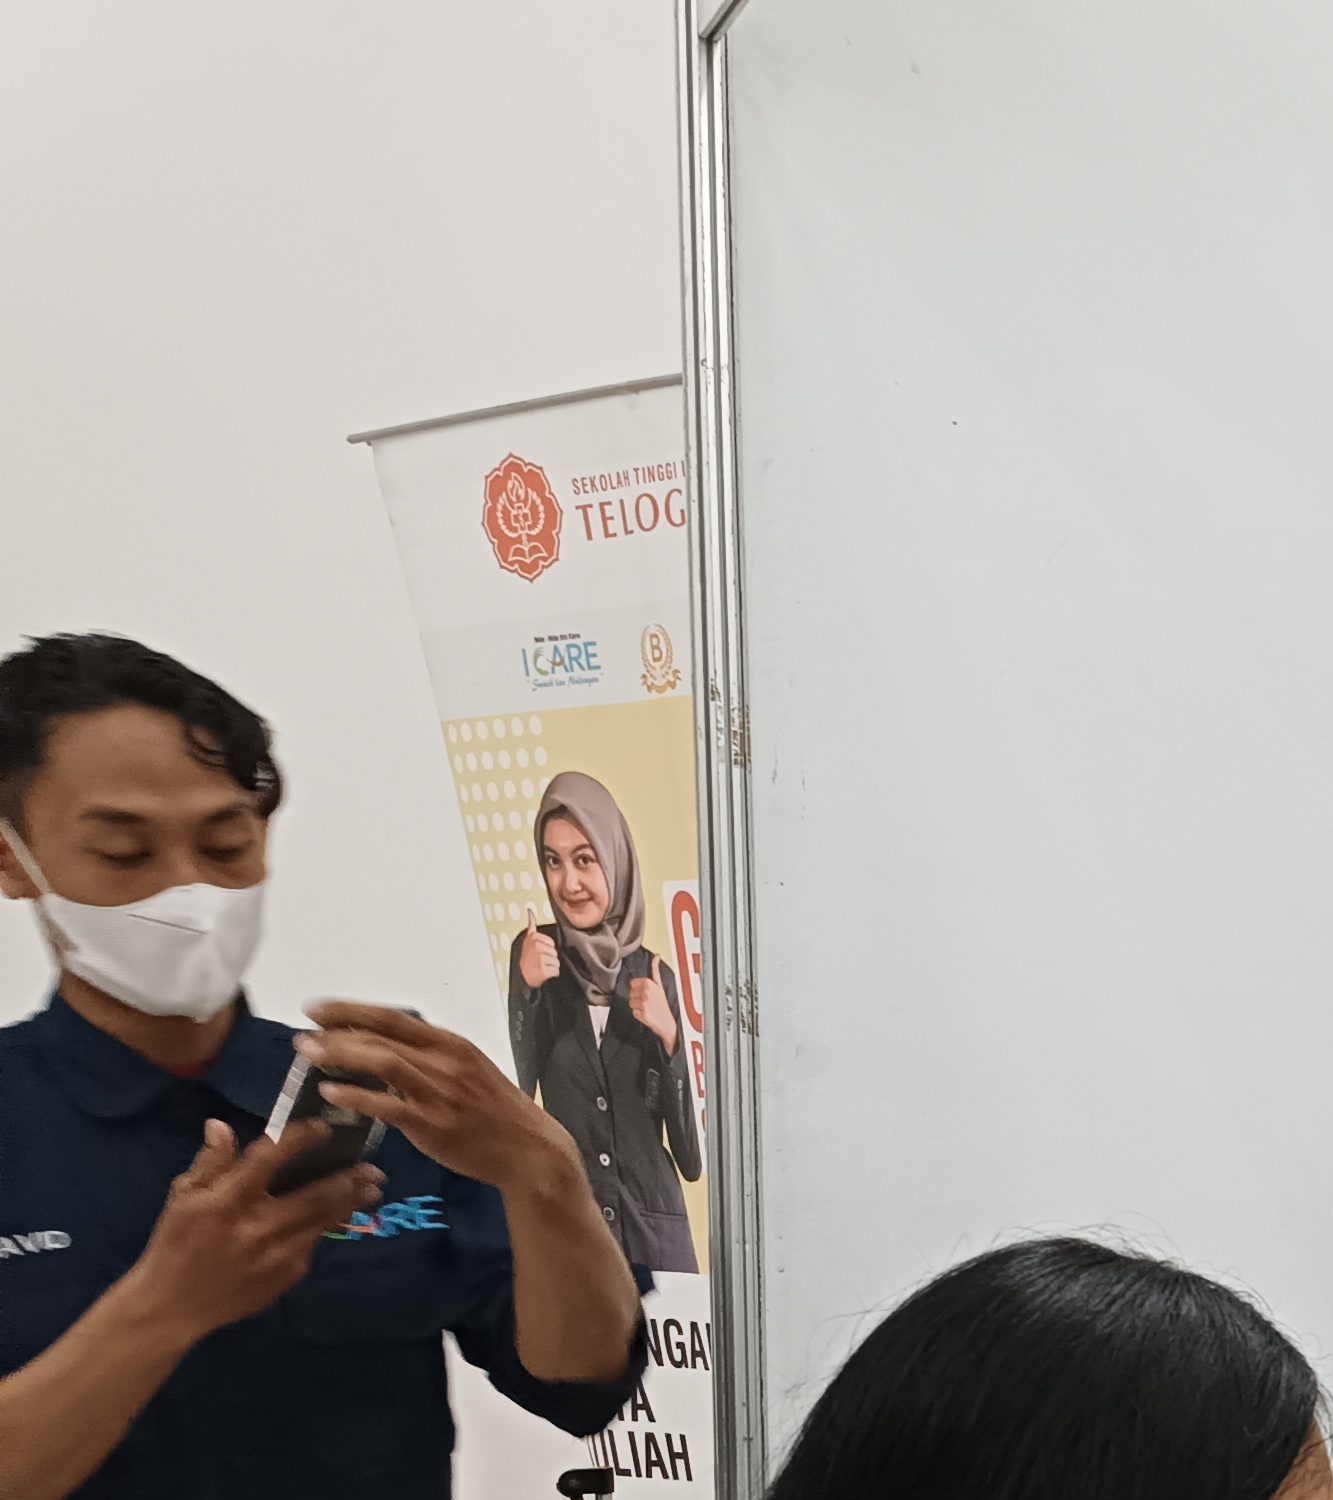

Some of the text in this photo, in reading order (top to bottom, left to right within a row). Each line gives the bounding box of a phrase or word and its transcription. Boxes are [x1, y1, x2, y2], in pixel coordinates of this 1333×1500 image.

[571, 468, 631, 496] SEKOLAH
[633, 461, 678, 486] TINGGI
[533, 641, 602, 676] CARE
